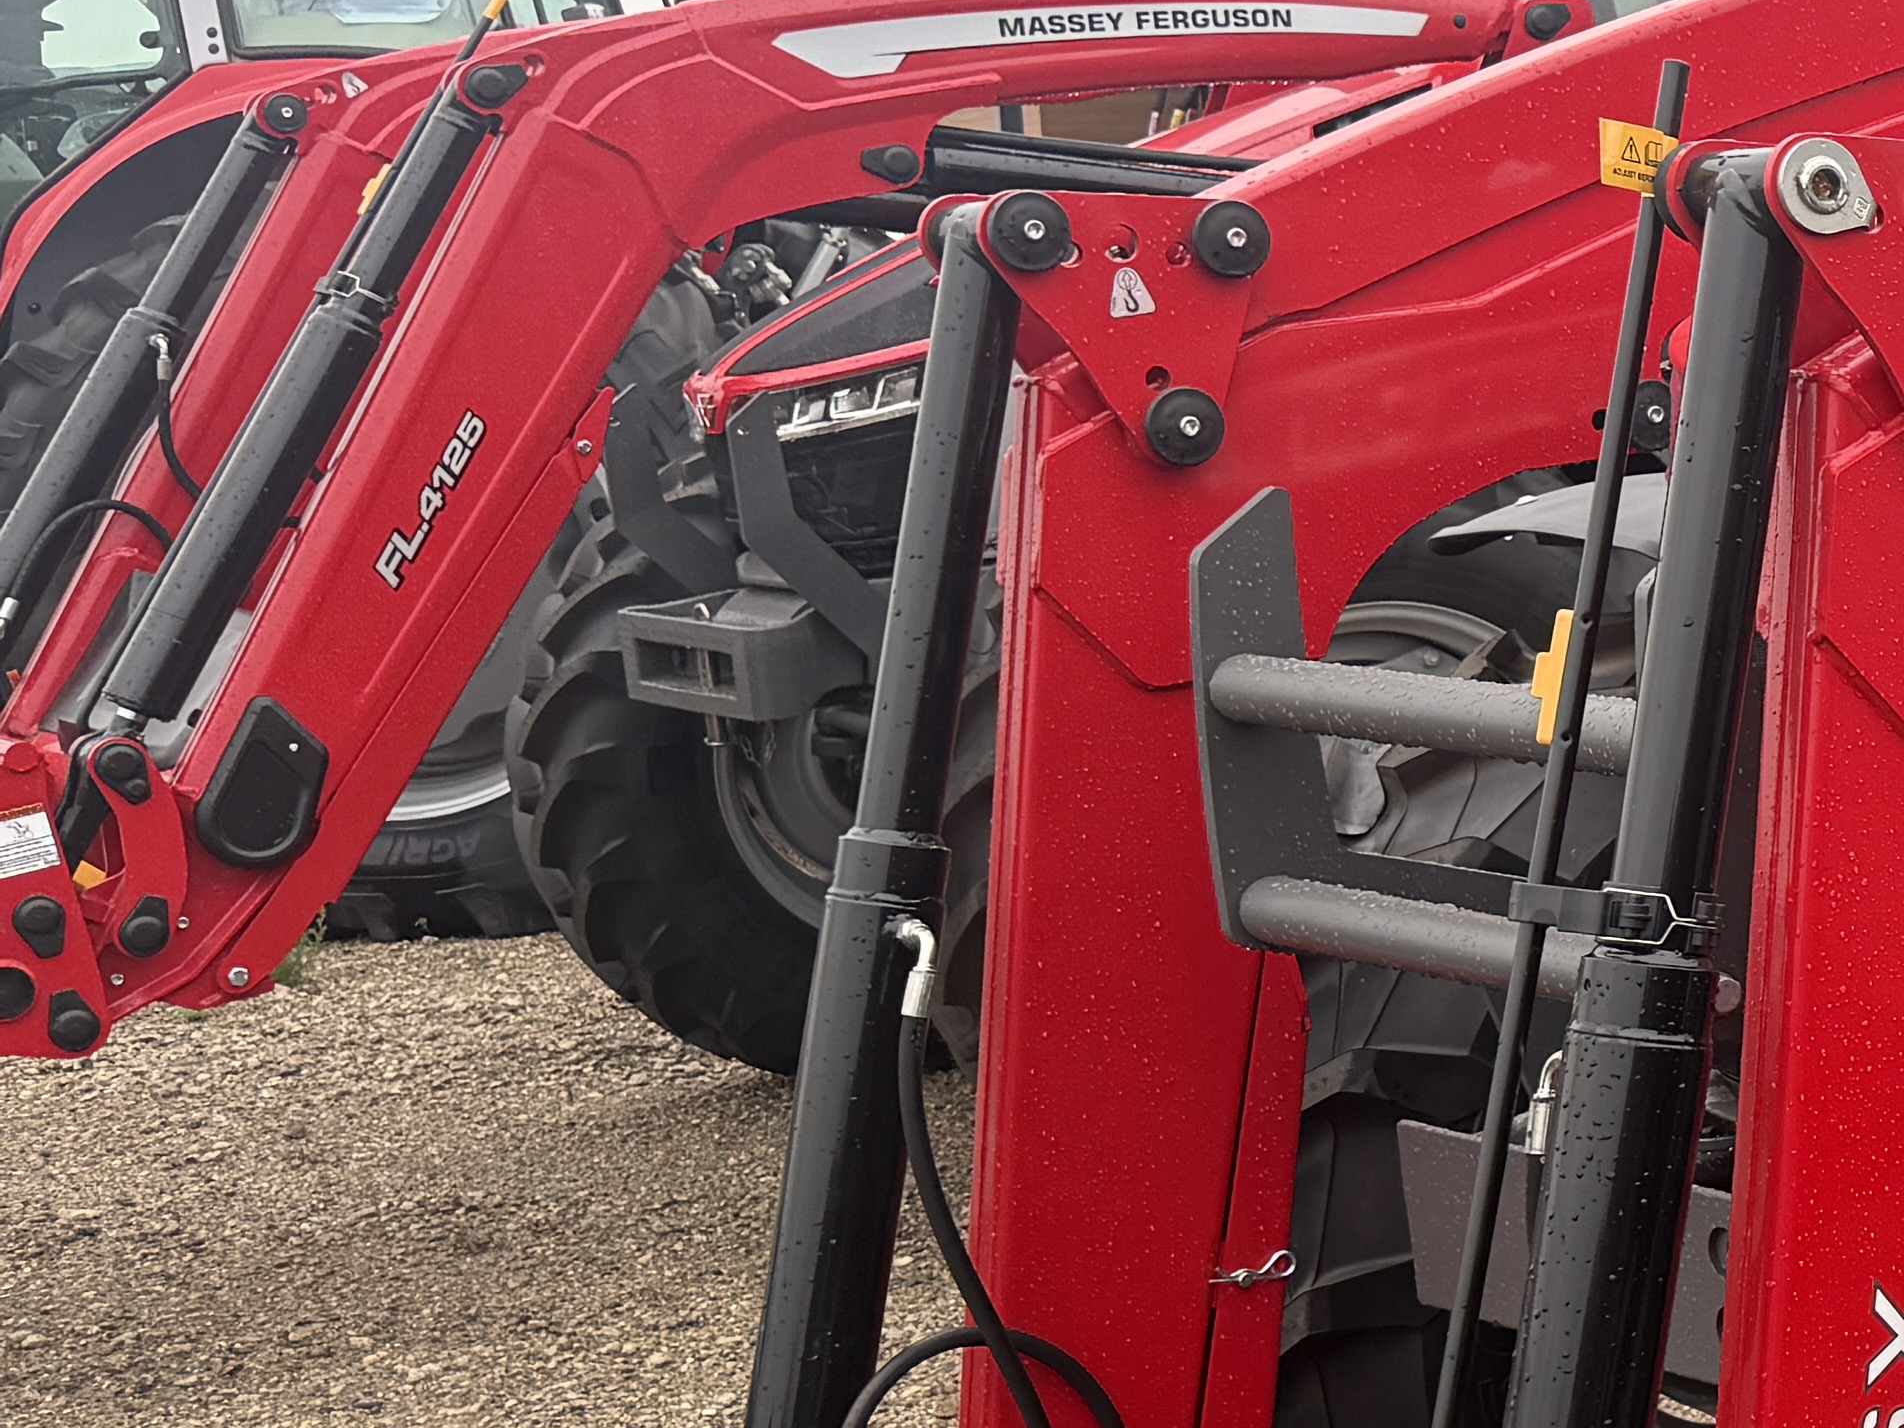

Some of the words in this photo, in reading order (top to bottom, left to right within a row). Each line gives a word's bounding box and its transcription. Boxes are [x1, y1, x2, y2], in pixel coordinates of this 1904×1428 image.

[999, 10, 1124, 39] MASSEY
[1136, 8, 1293, 33] FERGUSON
[372, 407, 488, 591] FL.4125
